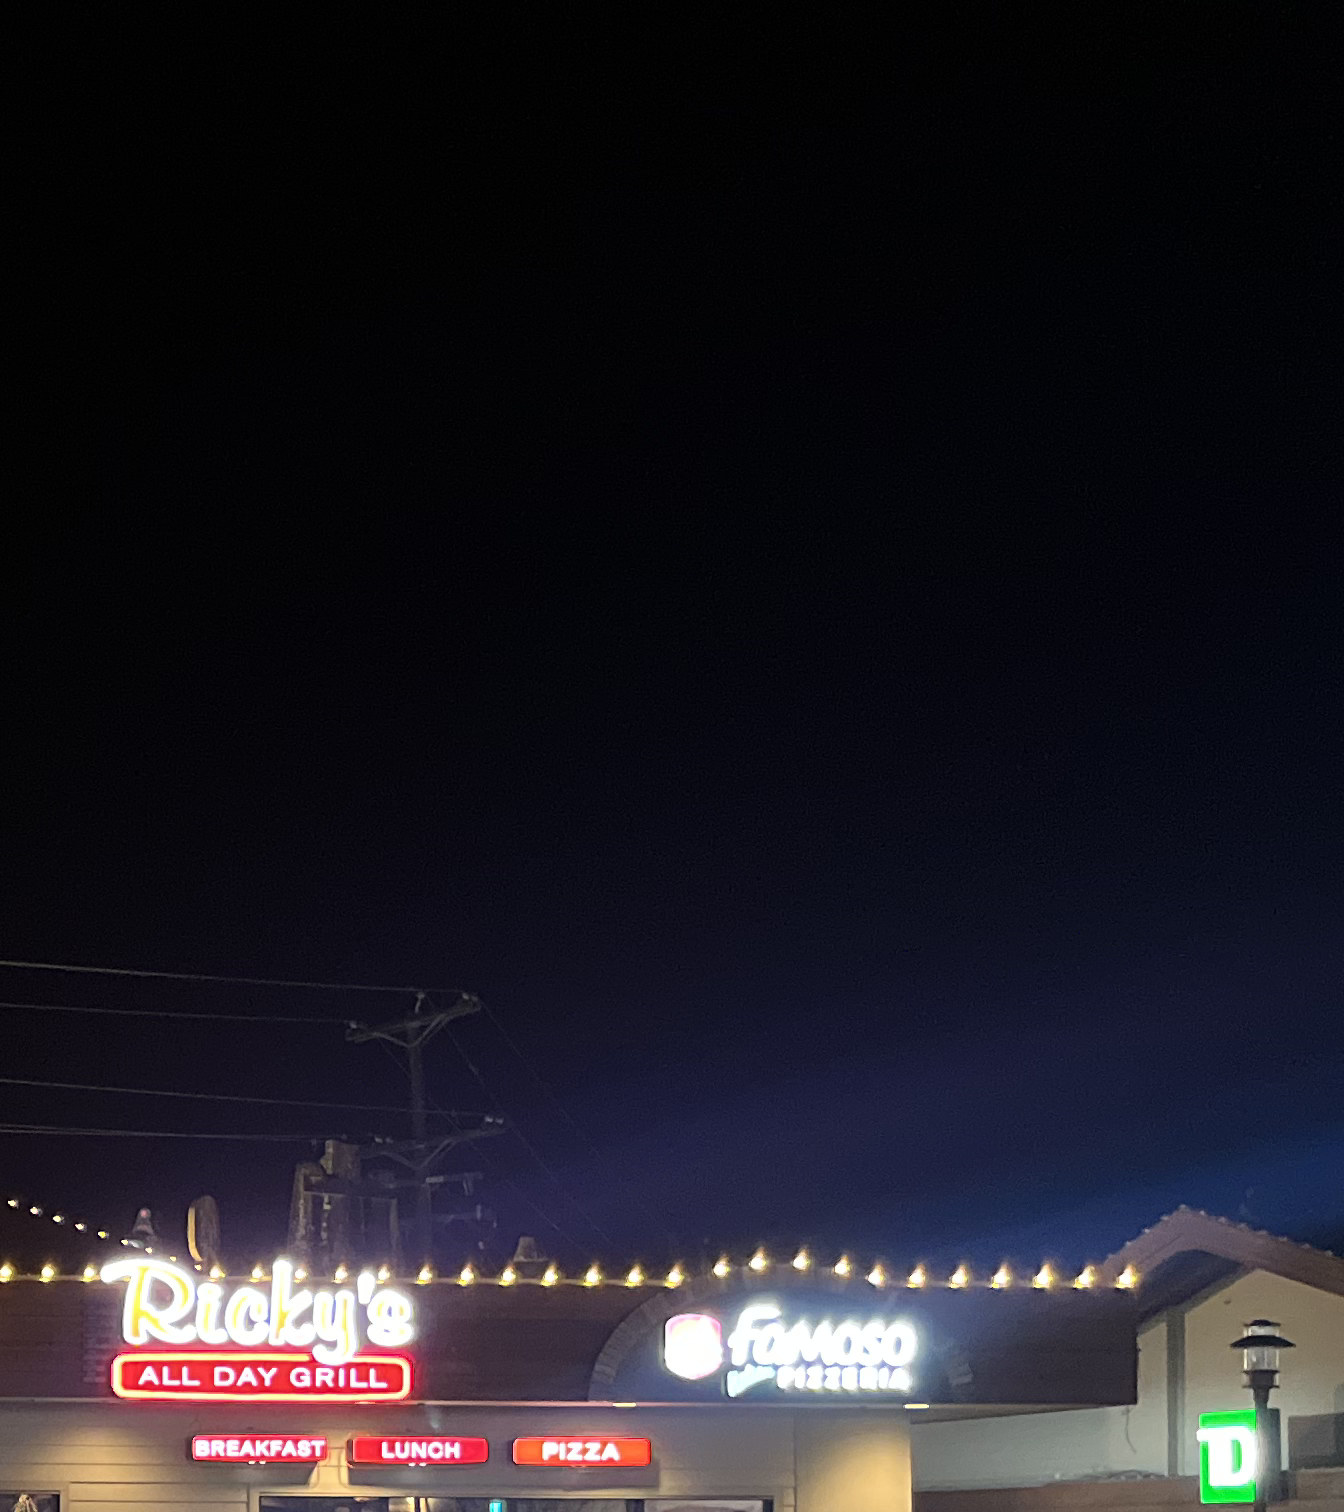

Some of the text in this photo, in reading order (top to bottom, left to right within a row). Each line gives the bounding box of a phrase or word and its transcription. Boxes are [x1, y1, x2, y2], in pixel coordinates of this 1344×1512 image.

[100, 1258, 415, 1366] Ricky's
[137, 1366, 389, 1389] ALL DAY GRILL
[194, 1439, 326, 1458] BREAKFAST
[380, 1441, 461, 1459] LUNCH
[541, 1441, 621, 1462] PIZZA
